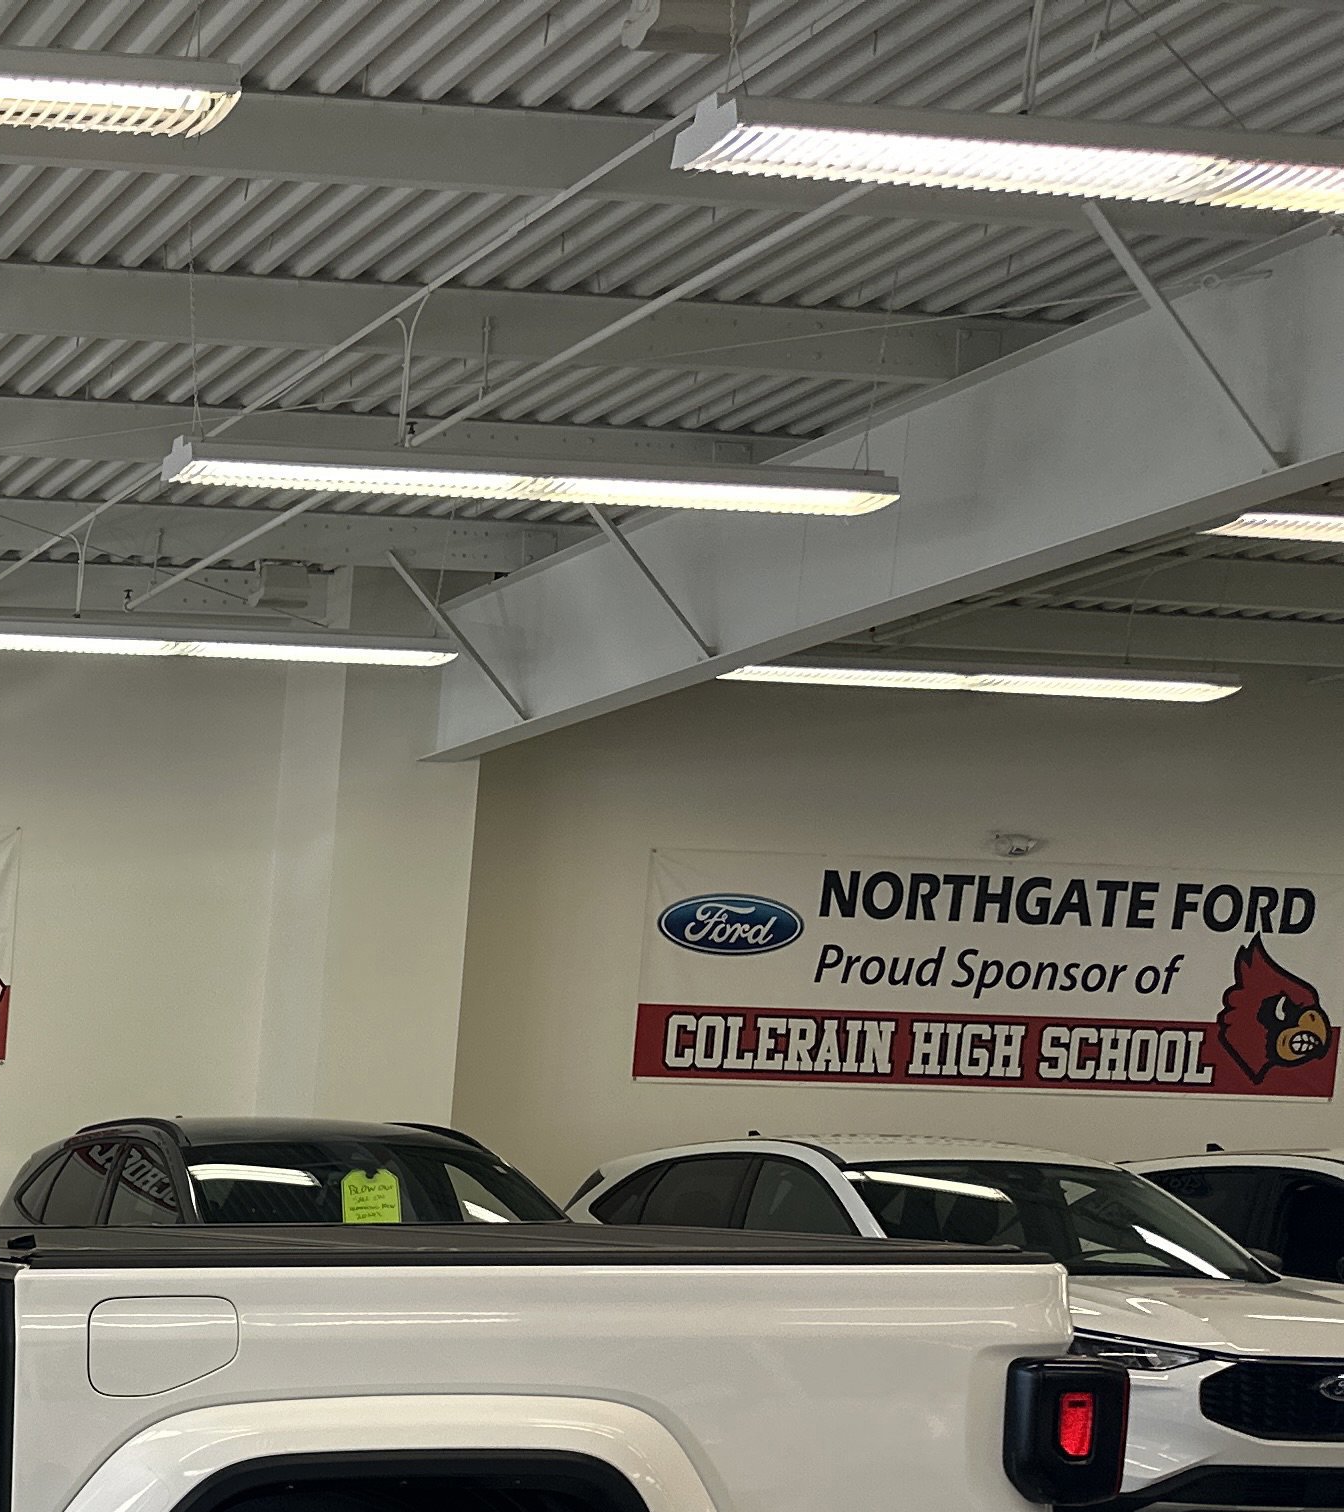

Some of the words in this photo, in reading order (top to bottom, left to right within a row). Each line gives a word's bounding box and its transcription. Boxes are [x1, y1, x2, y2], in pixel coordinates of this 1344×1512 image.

[683, 901, 779, 946] Ford
[818, 869, 1160, 930] NORTHGATE
[1170, 882, 1316, 935] FORD
[813, 943, 947, 988] Proud
[951, 947, 1128, 1000] Sponsor
[1134, 953, 1185, 996] of
[664, 1013, 896, 1076] COLERAIN
[907, 1021, 1026, 1078] HIGH
[1038, 1025, 1214, 1084] SCHOOL
